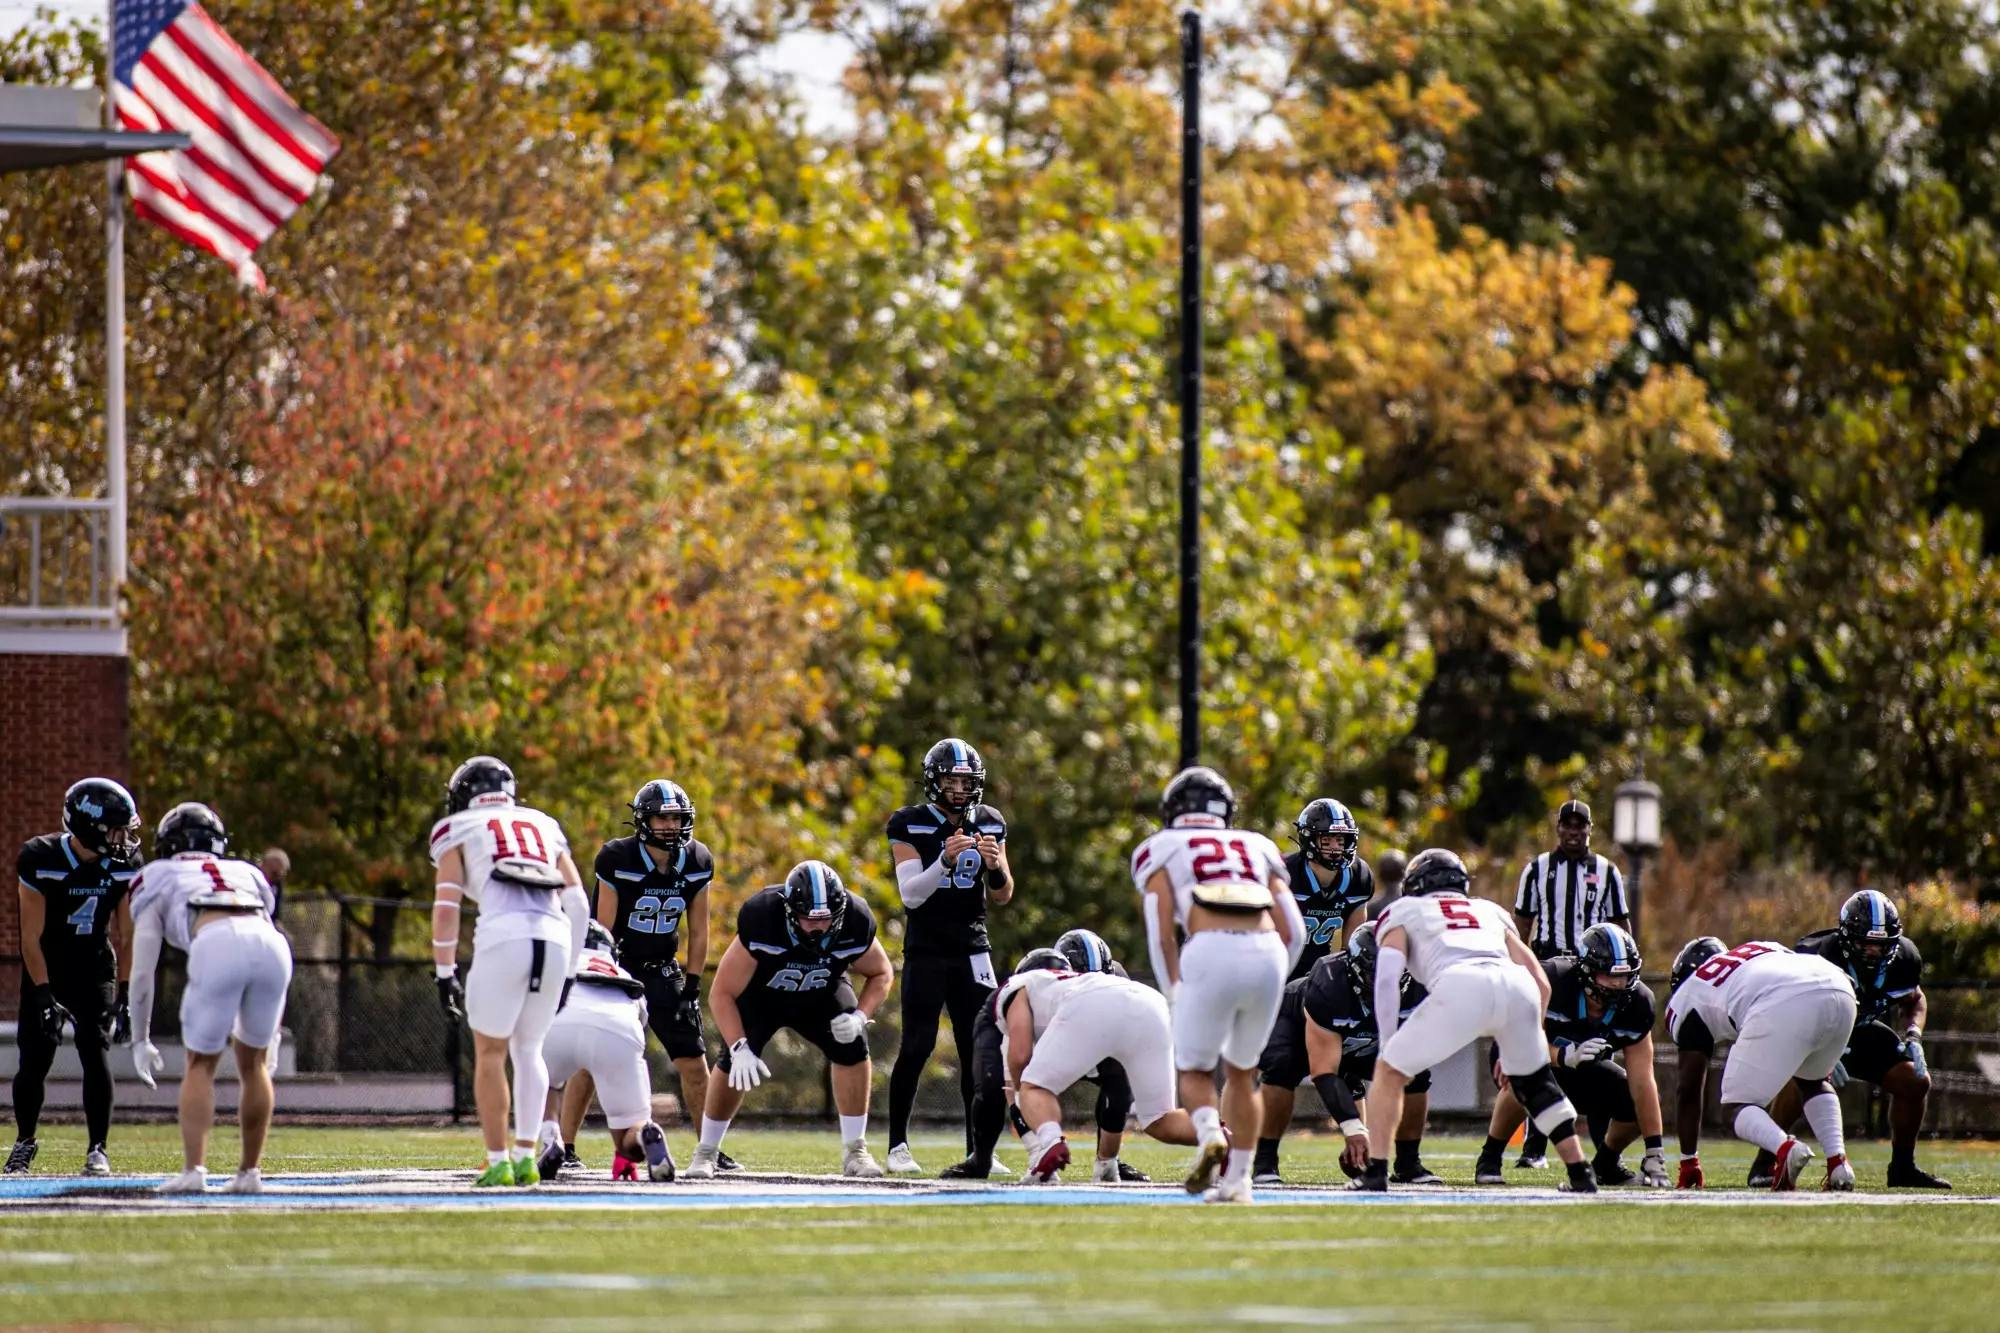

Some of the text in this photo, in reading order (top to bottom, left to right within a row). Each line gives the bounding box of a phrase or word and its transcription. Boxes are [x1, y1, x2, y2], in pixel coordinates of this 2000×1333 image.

[487, 819, 549, 864] 10
[937, 849, 981, 888] 8
[1188, 837, 1260, 883] 21
[69, 887, 108, 895] HOPKINS
[202, 863, 235, 893] 1
[644, 887, 680, 896] HOPKINS
[1586, 890, 1596, 902] U
[67, 895, 98, 935] 4
[628, 896, 687, 934] 22
[1306, 909, 1342, 917] HOPKINS
[1439, 899, 1480, 930] 5
[766, 968, 832, 992] 66
